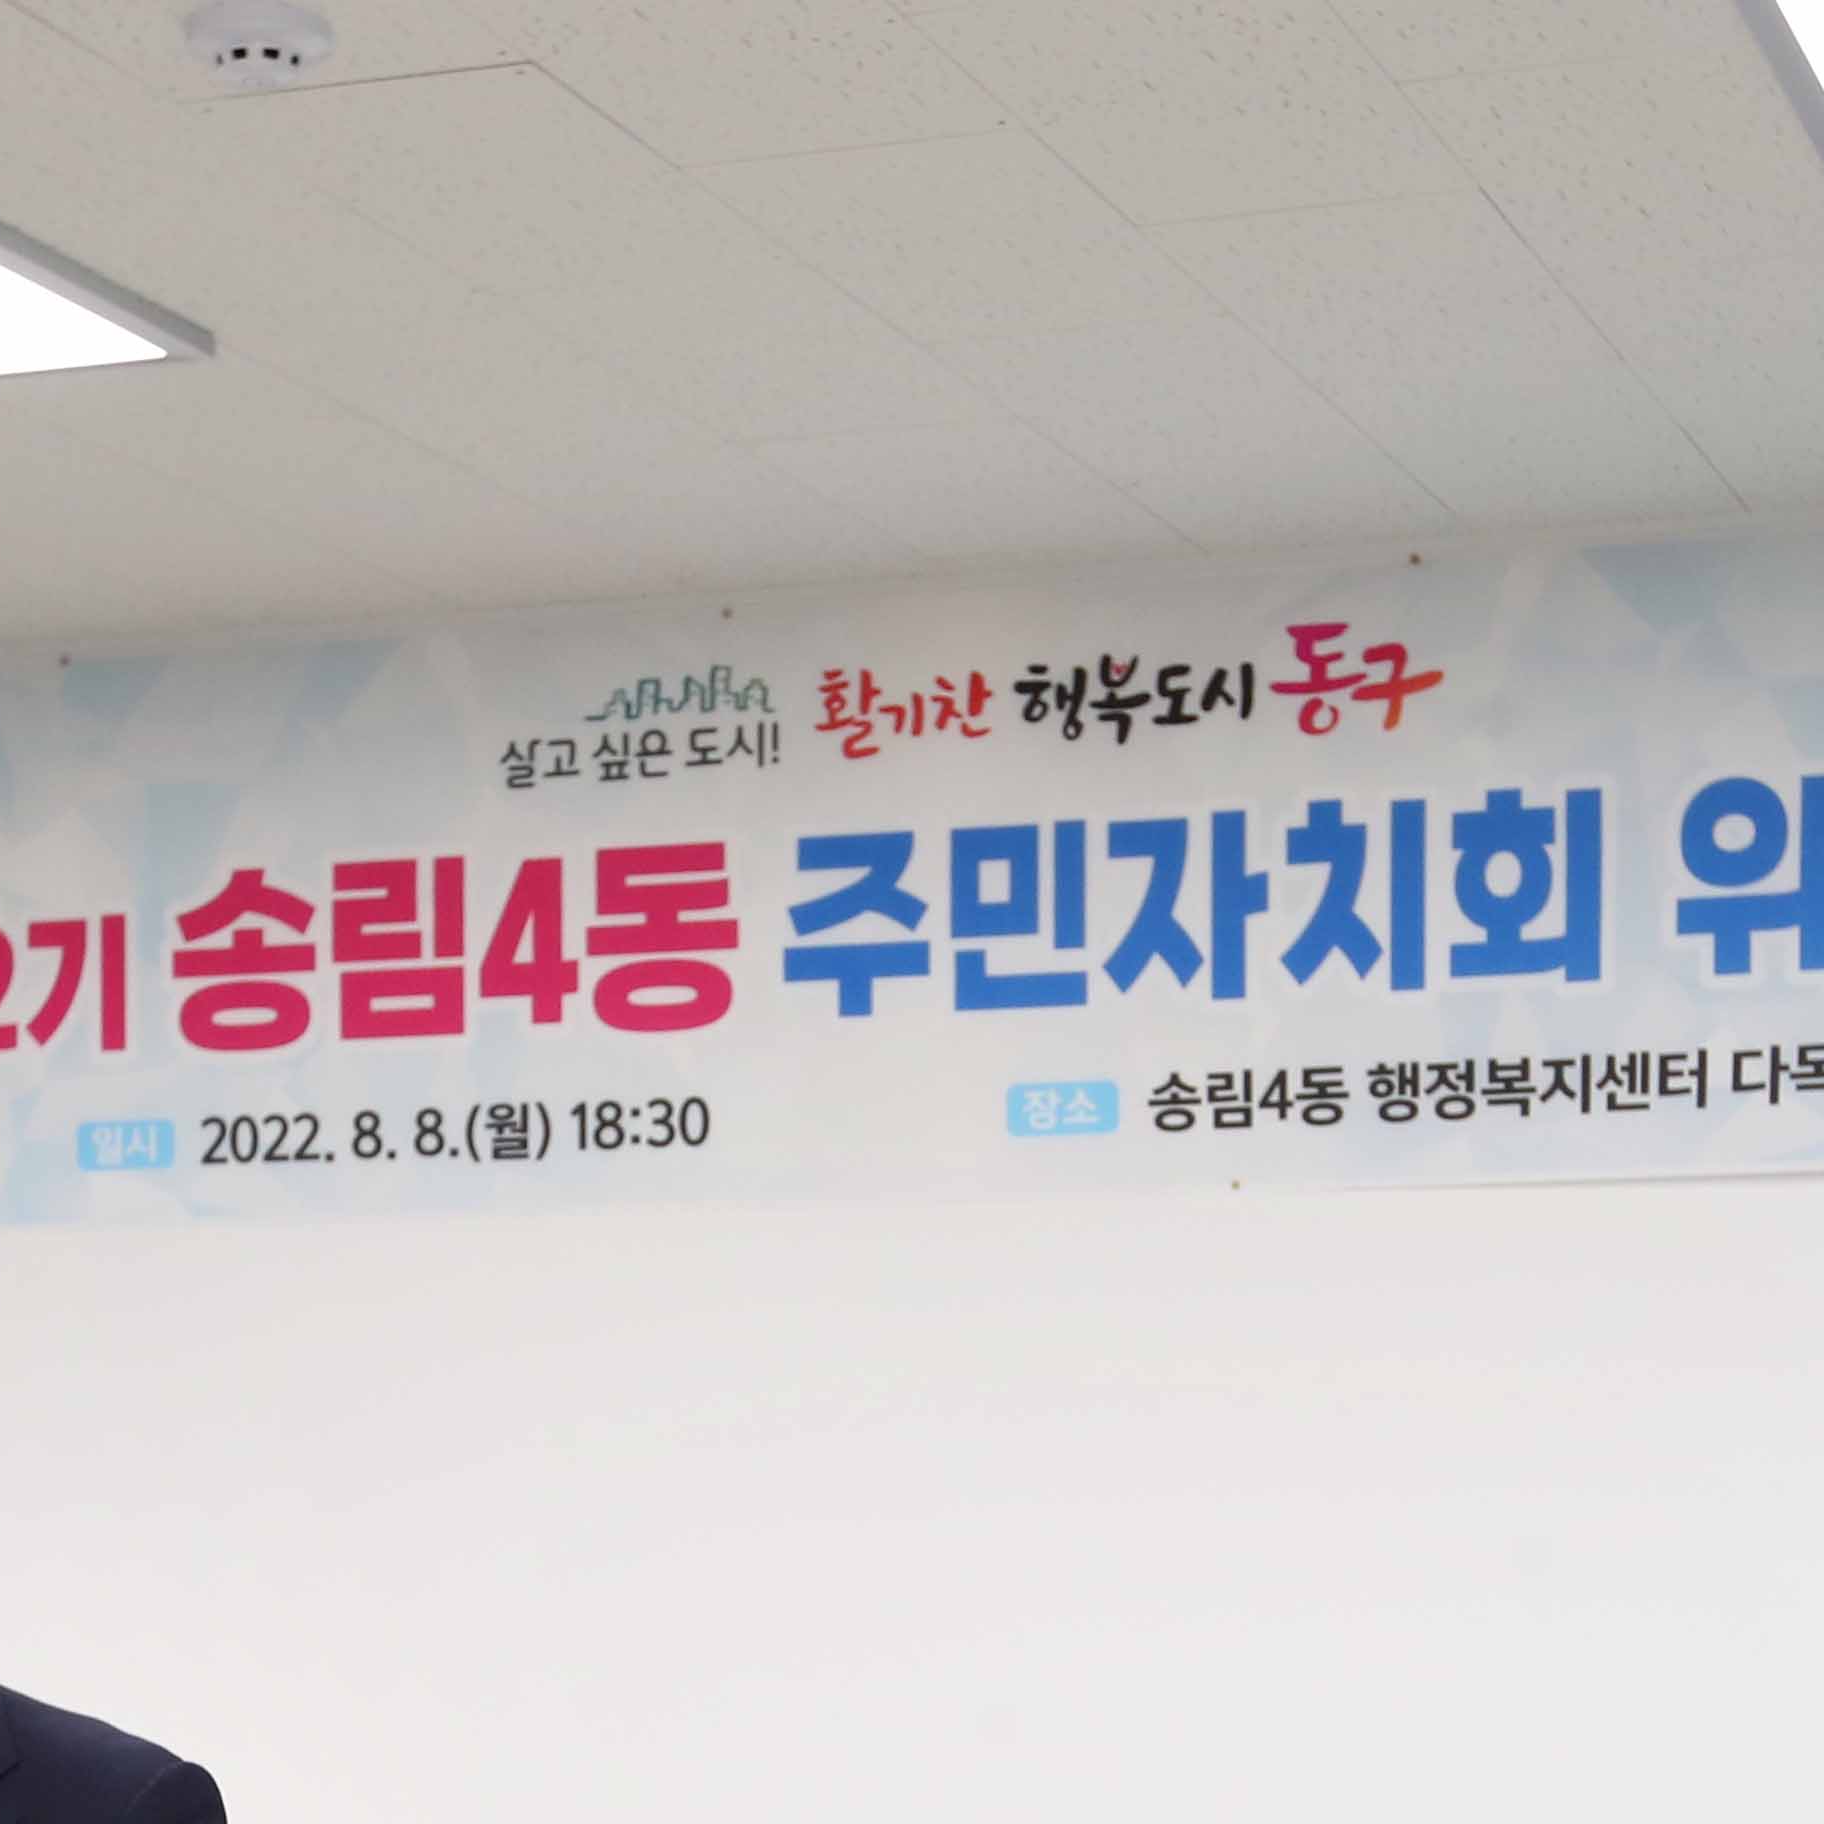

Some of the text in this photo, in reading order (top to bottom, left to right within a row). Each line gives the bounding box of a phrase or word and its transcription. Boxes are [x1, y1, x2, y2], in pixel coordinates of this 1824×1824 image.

[499, 622, 1444, 789] 살고 싶은 도시! 활기찬 행복도시 동구
[172, 841, 741, 1053] 송림4동
[783, 788, 1602, 1017] 주민자치회
[201, 1113, 334, 1164] 2022.
[352, 1110, 396, 1159] 8.
[571, 1097, 710, 1150] 18:30
[1021, 1089, 1101, 1131] 장소
[1148, 1066, 1350, 1132] 송림4동
[1367, 1049, 1708, 1123] 행정복지센터
